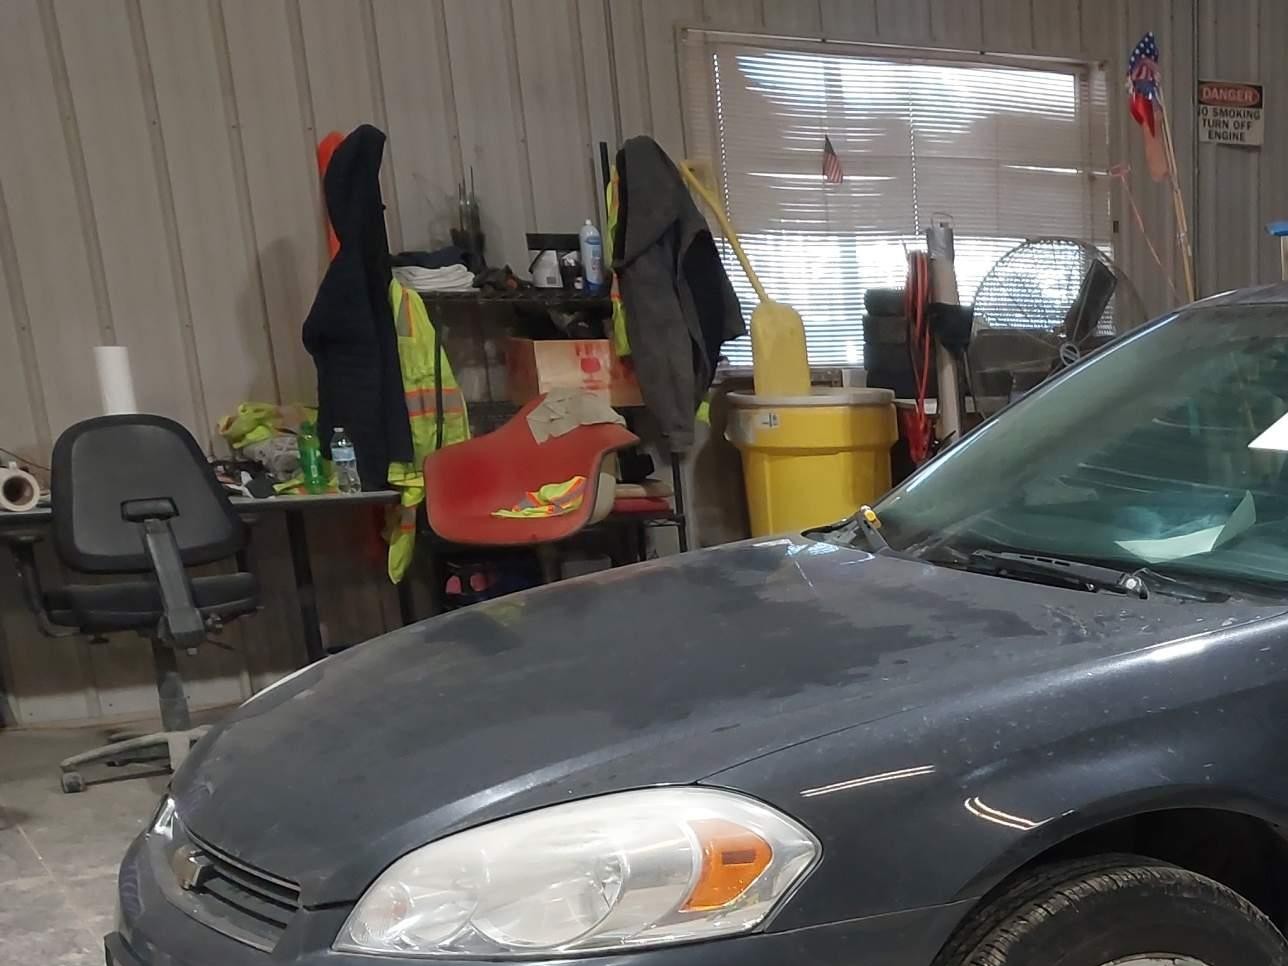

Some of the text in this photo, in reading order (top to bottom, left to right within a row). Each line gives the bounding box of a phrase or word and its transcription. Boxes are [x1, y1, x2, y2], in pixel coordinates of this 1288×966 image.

[1202, 87, 1254, 102] DANGER
[1212, 107, 1261, 120] SMOKING
[1202, 118, 1252, 131] TURN OFF
[1208, 129, 1246, 142] ENGINE
